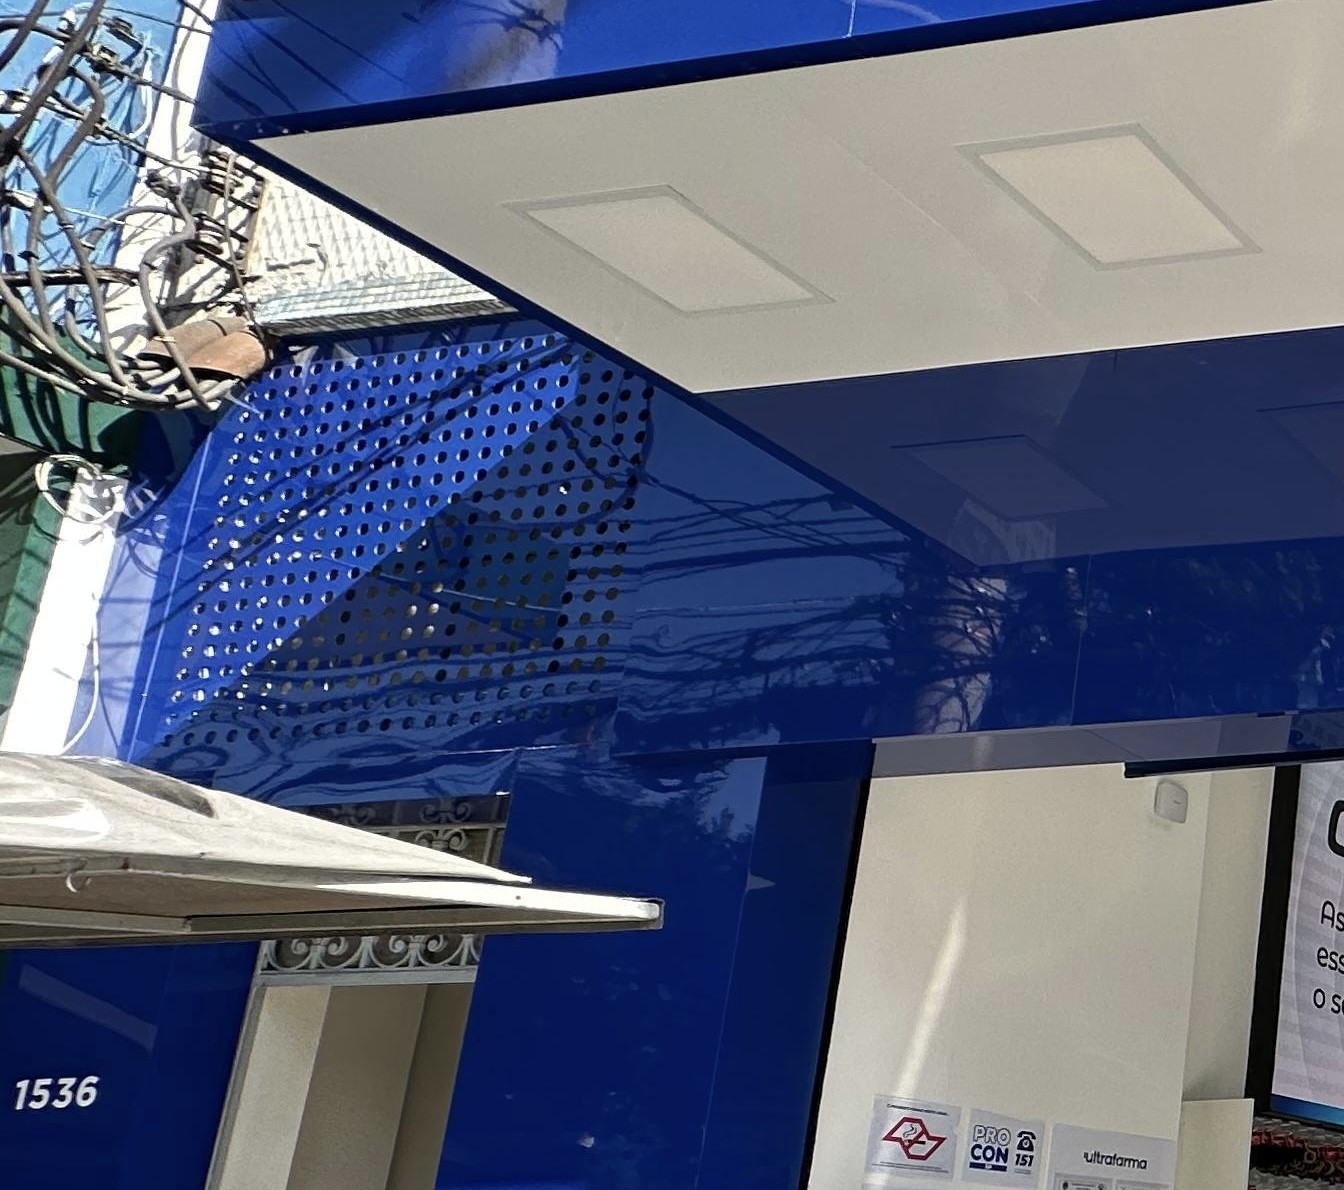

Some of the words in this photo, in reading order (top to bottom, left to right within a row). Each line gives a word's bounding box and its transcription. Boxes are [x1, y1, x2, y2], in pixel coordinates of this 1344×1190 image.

[1313, 988, 1326, 1009] o
[16, 1075, 100, 1110] 1536
[973, 1124, 1011, 1147] PRO
[970, 1143, 1009, 1164] CON
[1015, 1153, 1035, 1167] 151
[1083, 1150, 1148, 1170] ultrafarma
